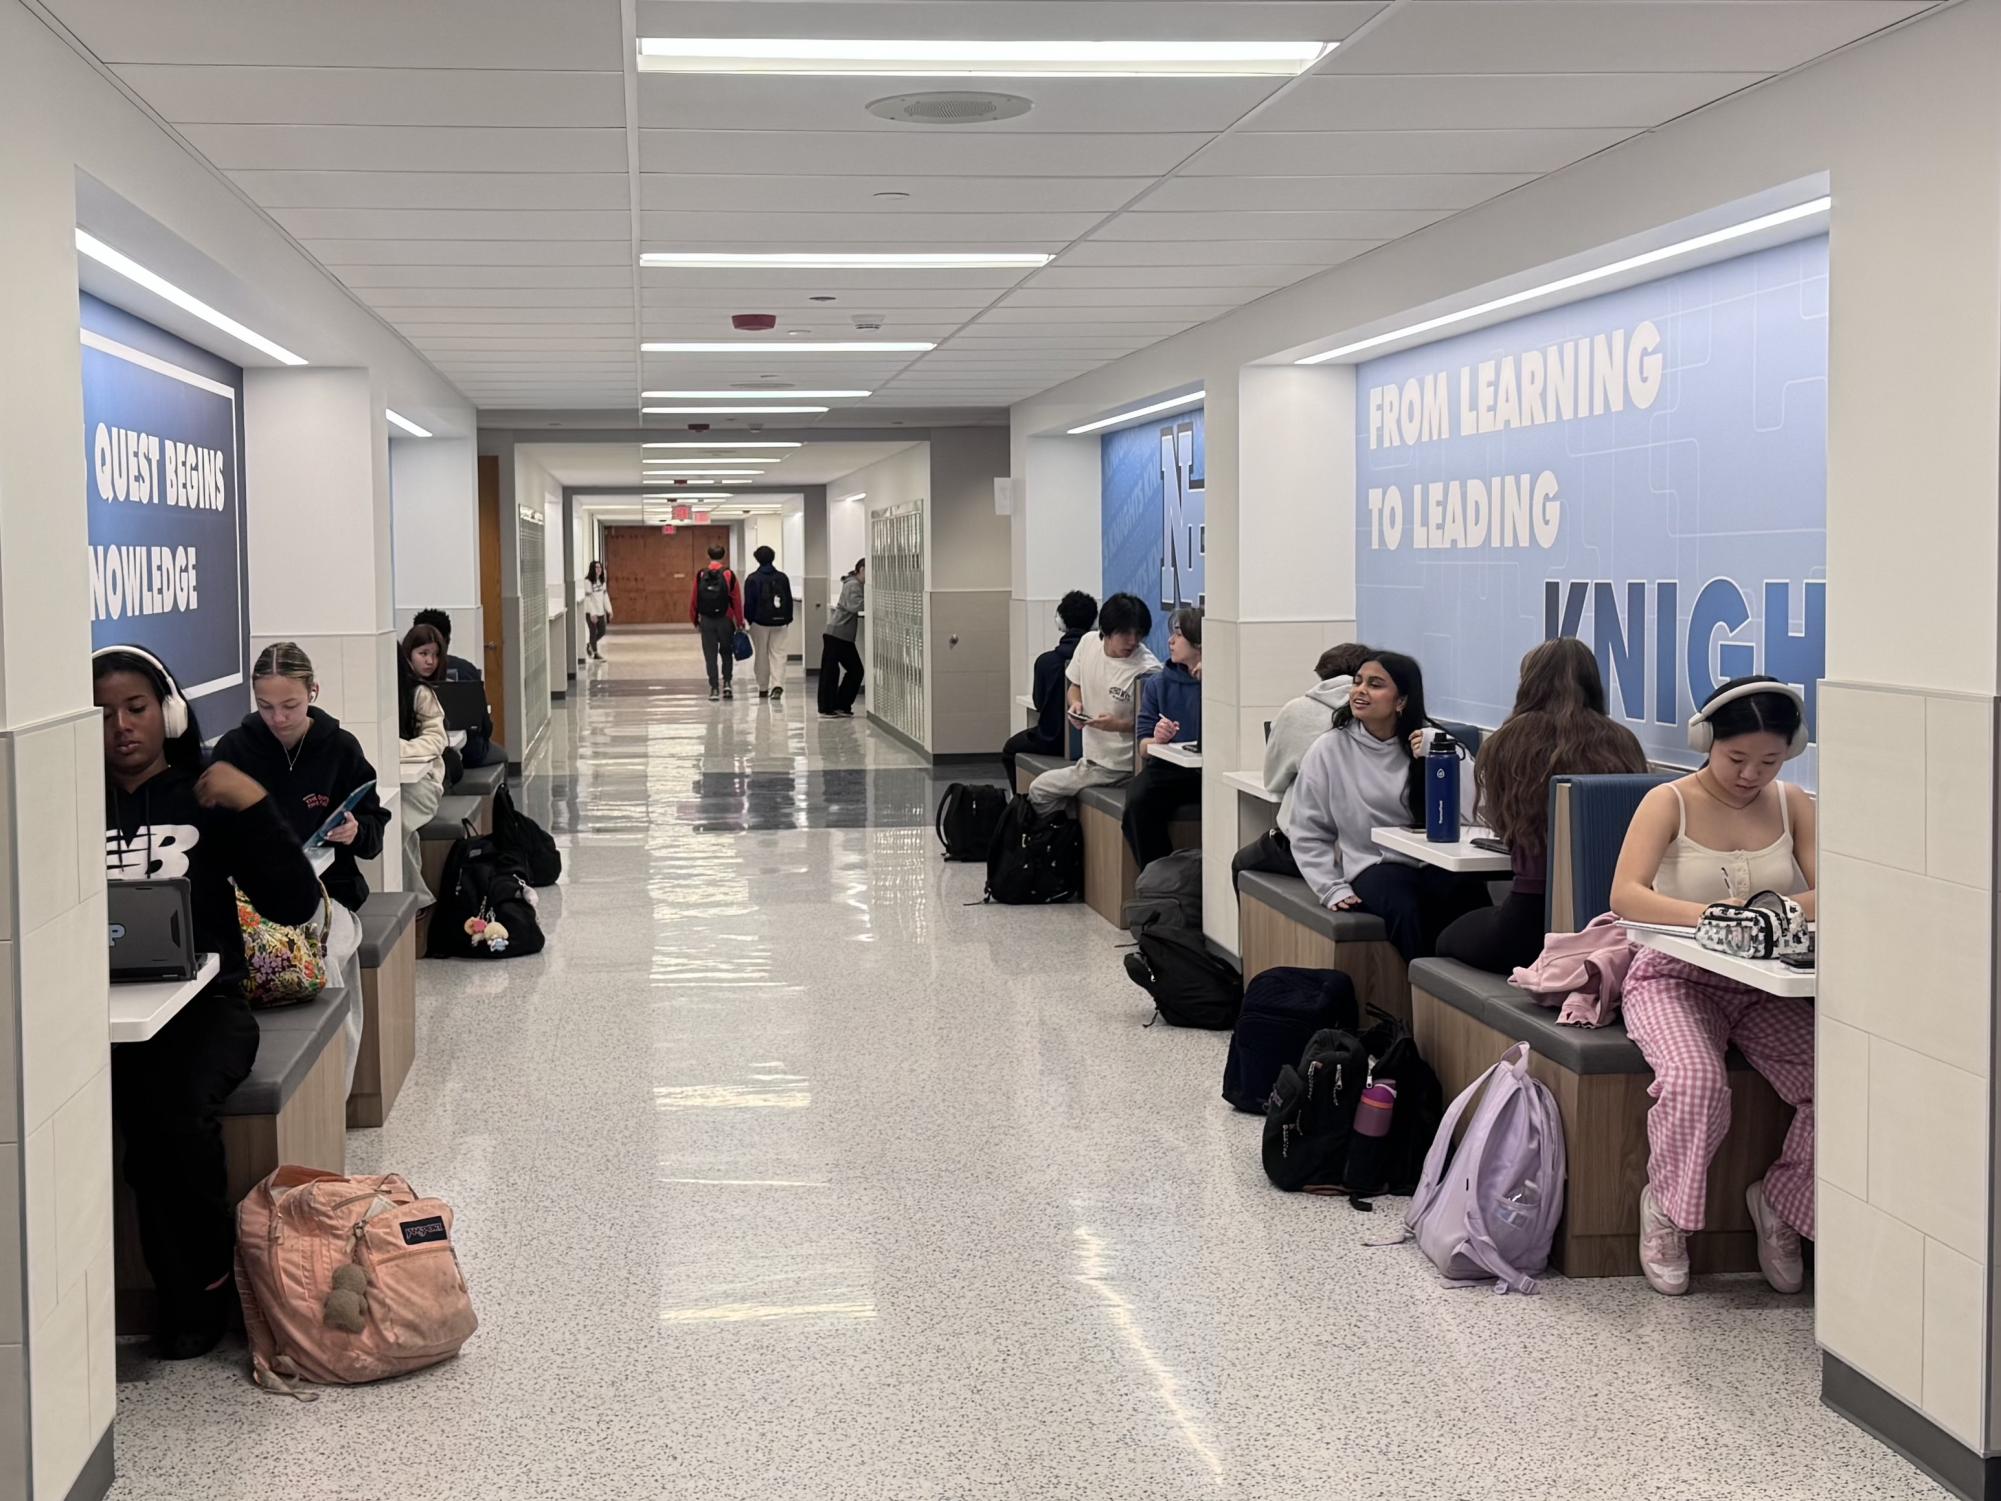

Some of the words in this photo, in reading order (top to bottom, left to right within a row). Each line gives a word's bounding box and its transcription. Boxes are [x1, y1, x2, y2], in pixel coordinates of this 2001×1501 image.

[1369, 371, 1450, 450] FROM
[1460, 320, 1663, 436] LEARNING
[94, 422, 160, 504] QUEST
[164, 440, 225, 512] BEGINS
[1368, 485, 1403, 550] TO
[1413, 470, 1561, 549] LEADING
[87, 544, 198, 622] NOWLEDGE
